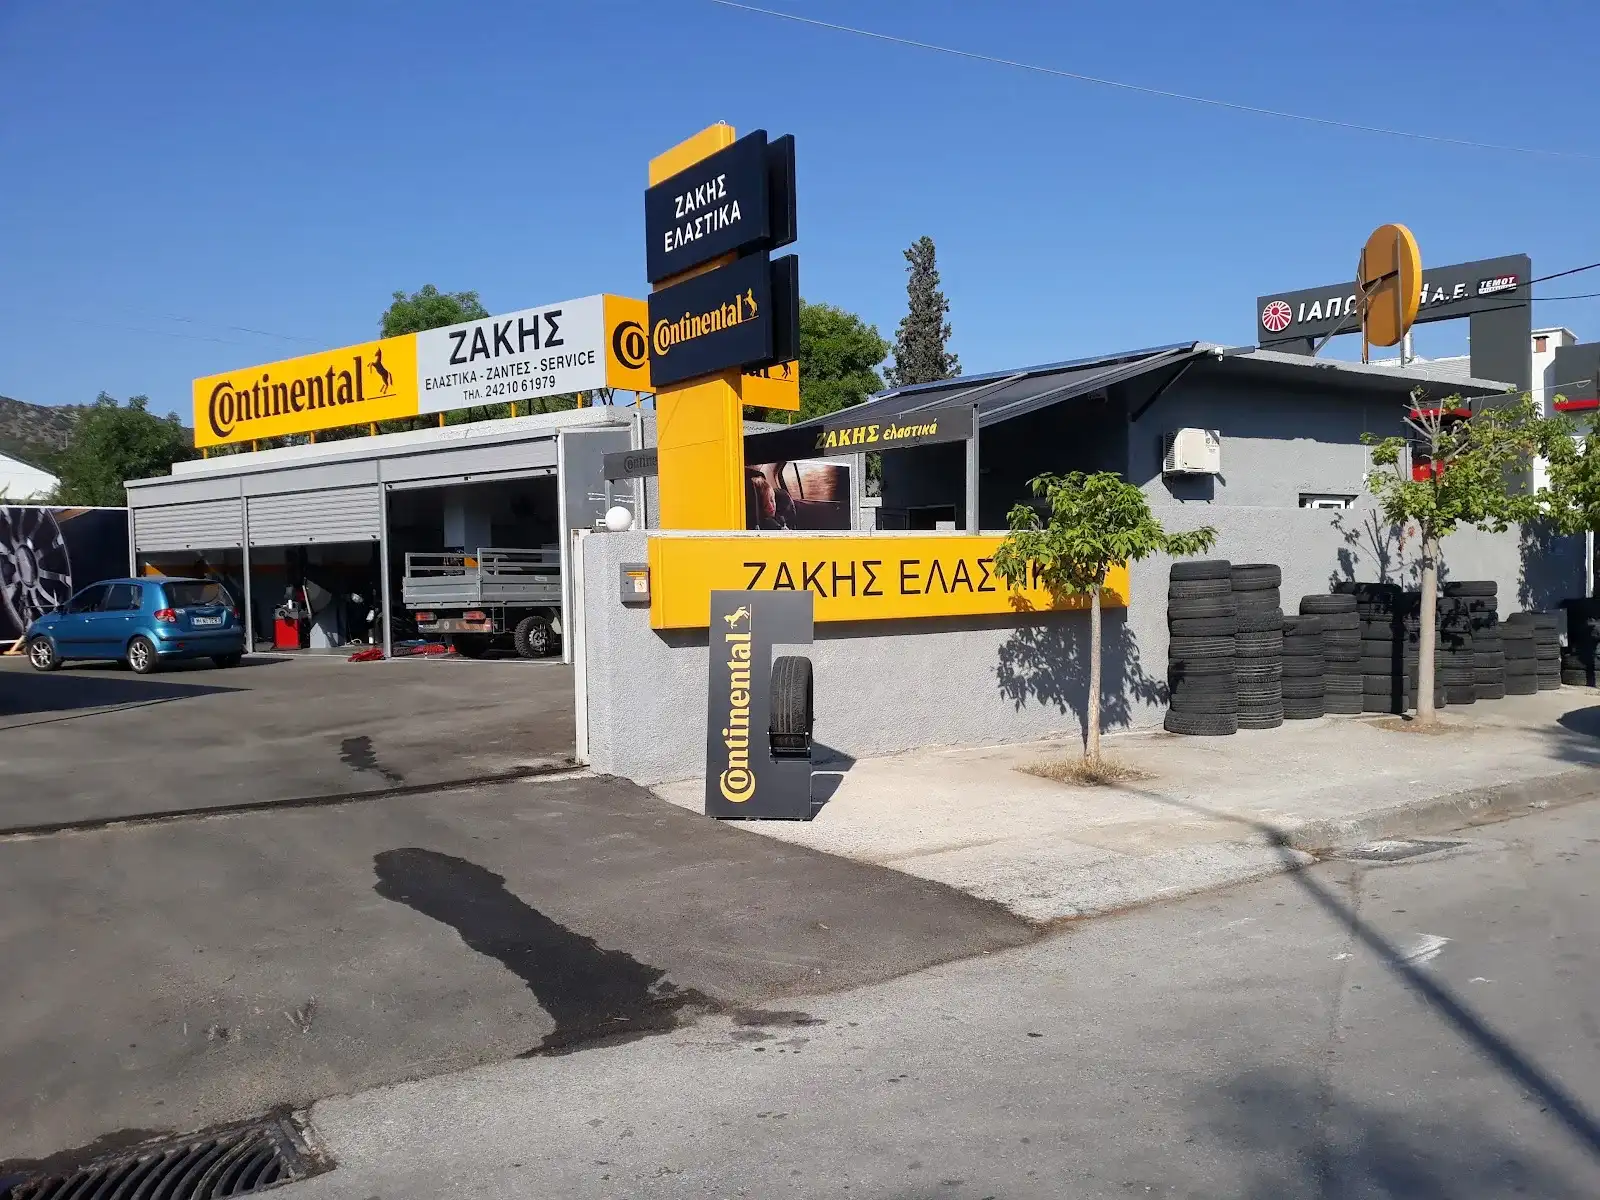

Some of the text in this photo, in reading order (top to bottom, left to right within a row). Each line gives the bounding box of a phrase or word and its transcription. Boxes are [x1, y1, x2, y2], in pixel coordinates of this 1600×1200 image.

[674, 172, 728, 219] ΖΑΚΗΣ
[663, 199, 742, 253] ΕΛΑΣΤΙΚΑ
[1480, 276, 1515, 290] TEMOT
[448, 309, 565, 366] ΖΑΚΗΣ
[652, 294, 743, 357] Continental
[425, 370, 477, 391] ΕΛΑΣΤΙΚΑ
[486, 361, 531, 381] ΖΑΝΤΕΣ
[540, 350, 596, 372] SERVICE
[463, 375, 556, 401] ΤΗΛ. 24210 61979
[208, 355, 365, 438] Continental
[814, 418, 939, 450] ΖΑΚΗΣ ελαστικά
[743, 560, 883, 598] ΖΑΚΗΣ
[719, 632, 756, 803] Continental
